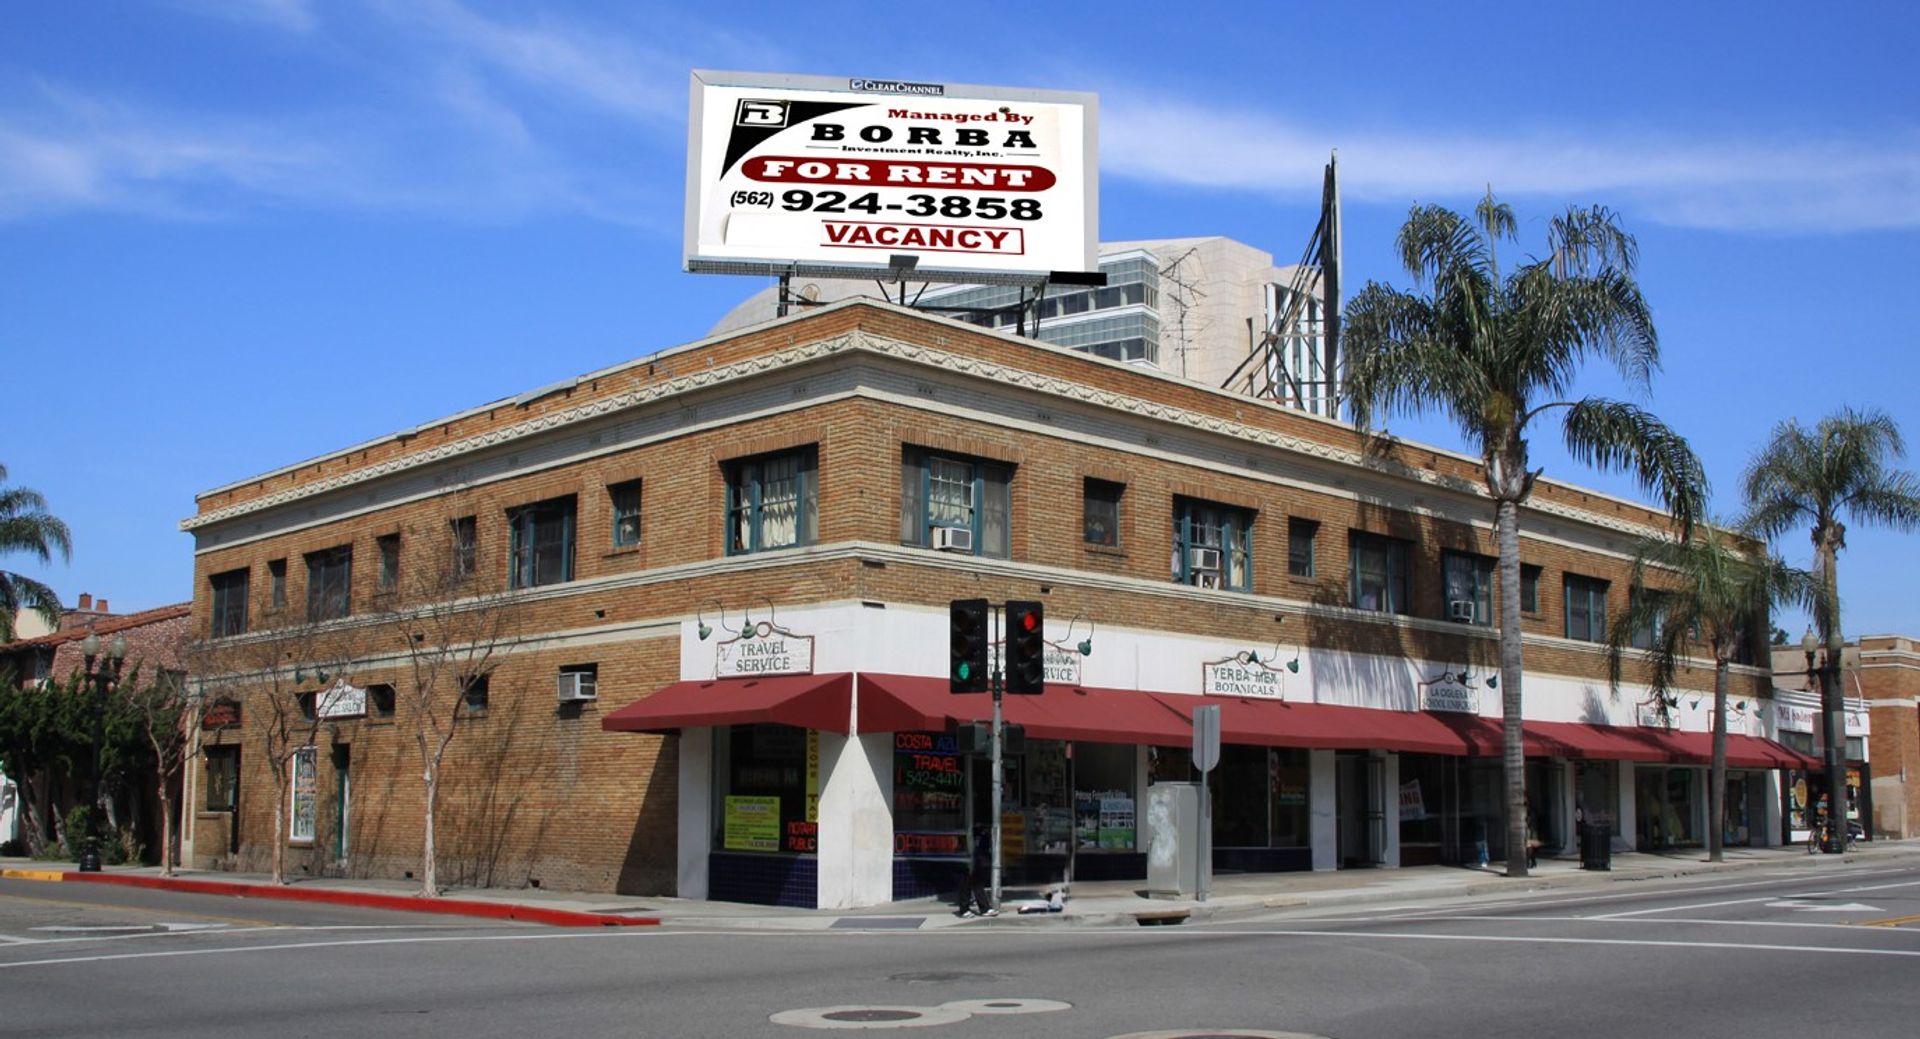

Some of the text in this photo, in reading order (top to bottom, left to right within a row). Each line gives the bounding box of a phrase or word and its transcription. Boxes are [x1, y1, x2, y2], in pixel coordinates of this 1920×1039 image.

[888, 109, 1034, 125] Managed By
[810, 123, 1037, 148] BORBA
[841, 145, 922, 154] Investment
[925, 148, 974, 157] Realty,
[761, 160, 1032, 187] FOR RENT
[730, 189, 1043, 221] (562) 924-3858
[825, 224, 1010, 249] VACANCY
[740, 641, 788, 657] TRAVEL
[736, 657, 791, 673] SERVICE
[1043, 667, 1073, 681] RVICE
[1212, 667, 1250, 681] YERBA
[1215, 681, 1275, 695] BOTANICALS
[896, 734, 933, 749] COSTA
[912, 755, 959, 772] TRAVEL
[789, 837, 816, 850] PUBLIC
